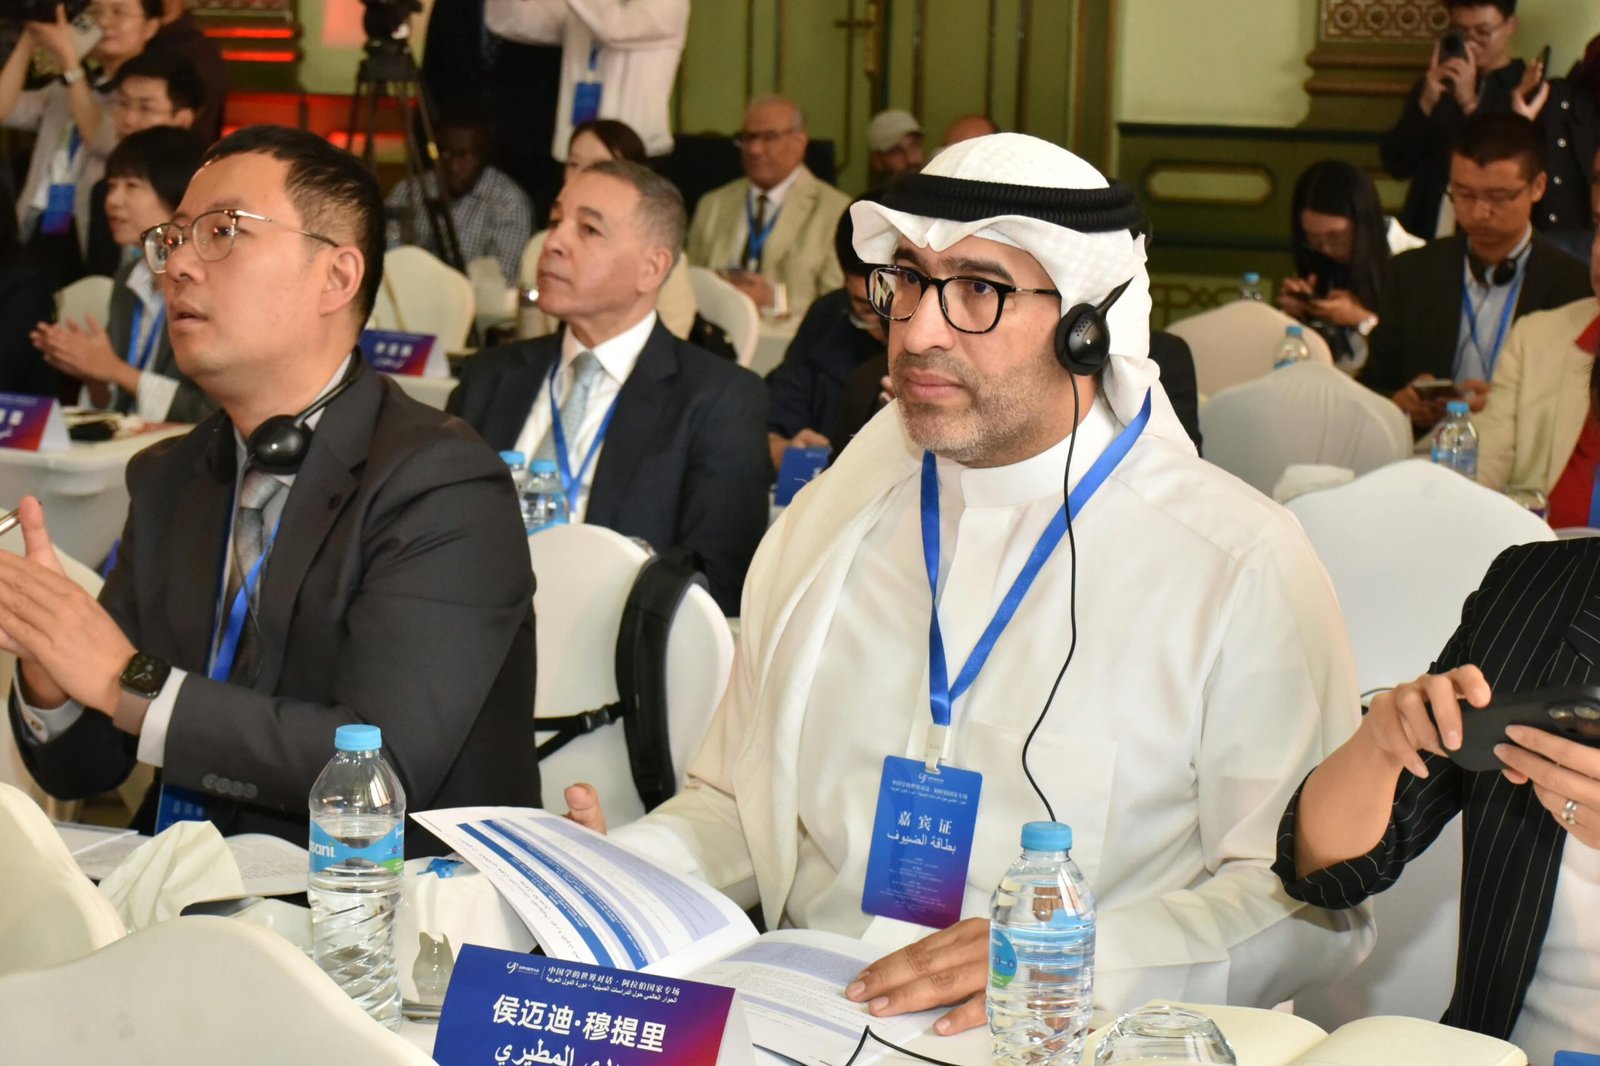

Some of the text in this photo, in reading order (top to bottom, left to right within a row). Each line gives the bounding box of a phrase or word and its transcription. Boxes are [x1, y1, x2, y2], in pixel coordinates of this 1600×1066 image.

[886, 829, 957, 855] بطاقة الضيوف
[494, 1038, 575, 1066] المطيري
